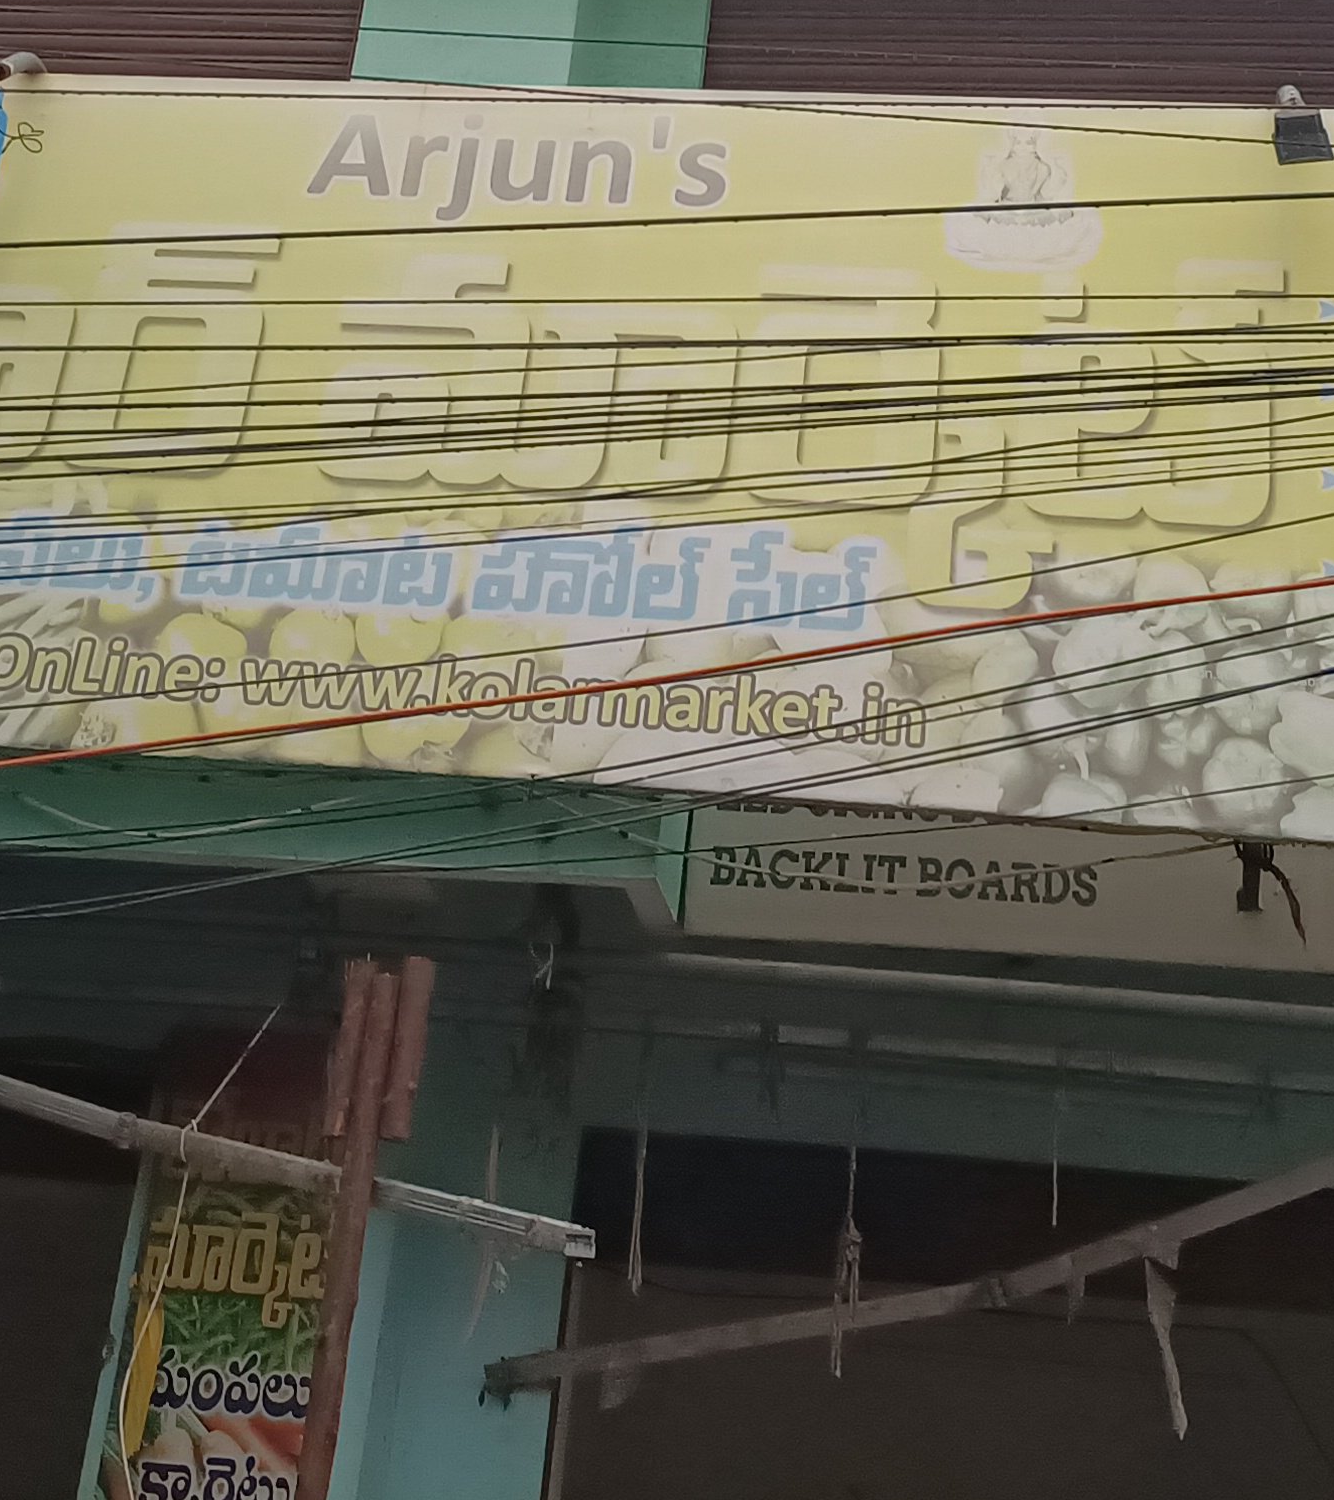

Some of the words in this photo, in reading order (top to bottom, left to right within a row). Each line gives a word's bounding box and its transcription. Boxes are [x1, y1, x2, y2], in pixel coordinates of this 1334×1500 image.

[308, 113, 730, 222] Arjun's
[239, 654, 931, 749] www.kolarmarket.in
[710, 845, 908, 896] BACKLIT
[916, 855, 1099, 908] BOARDS
